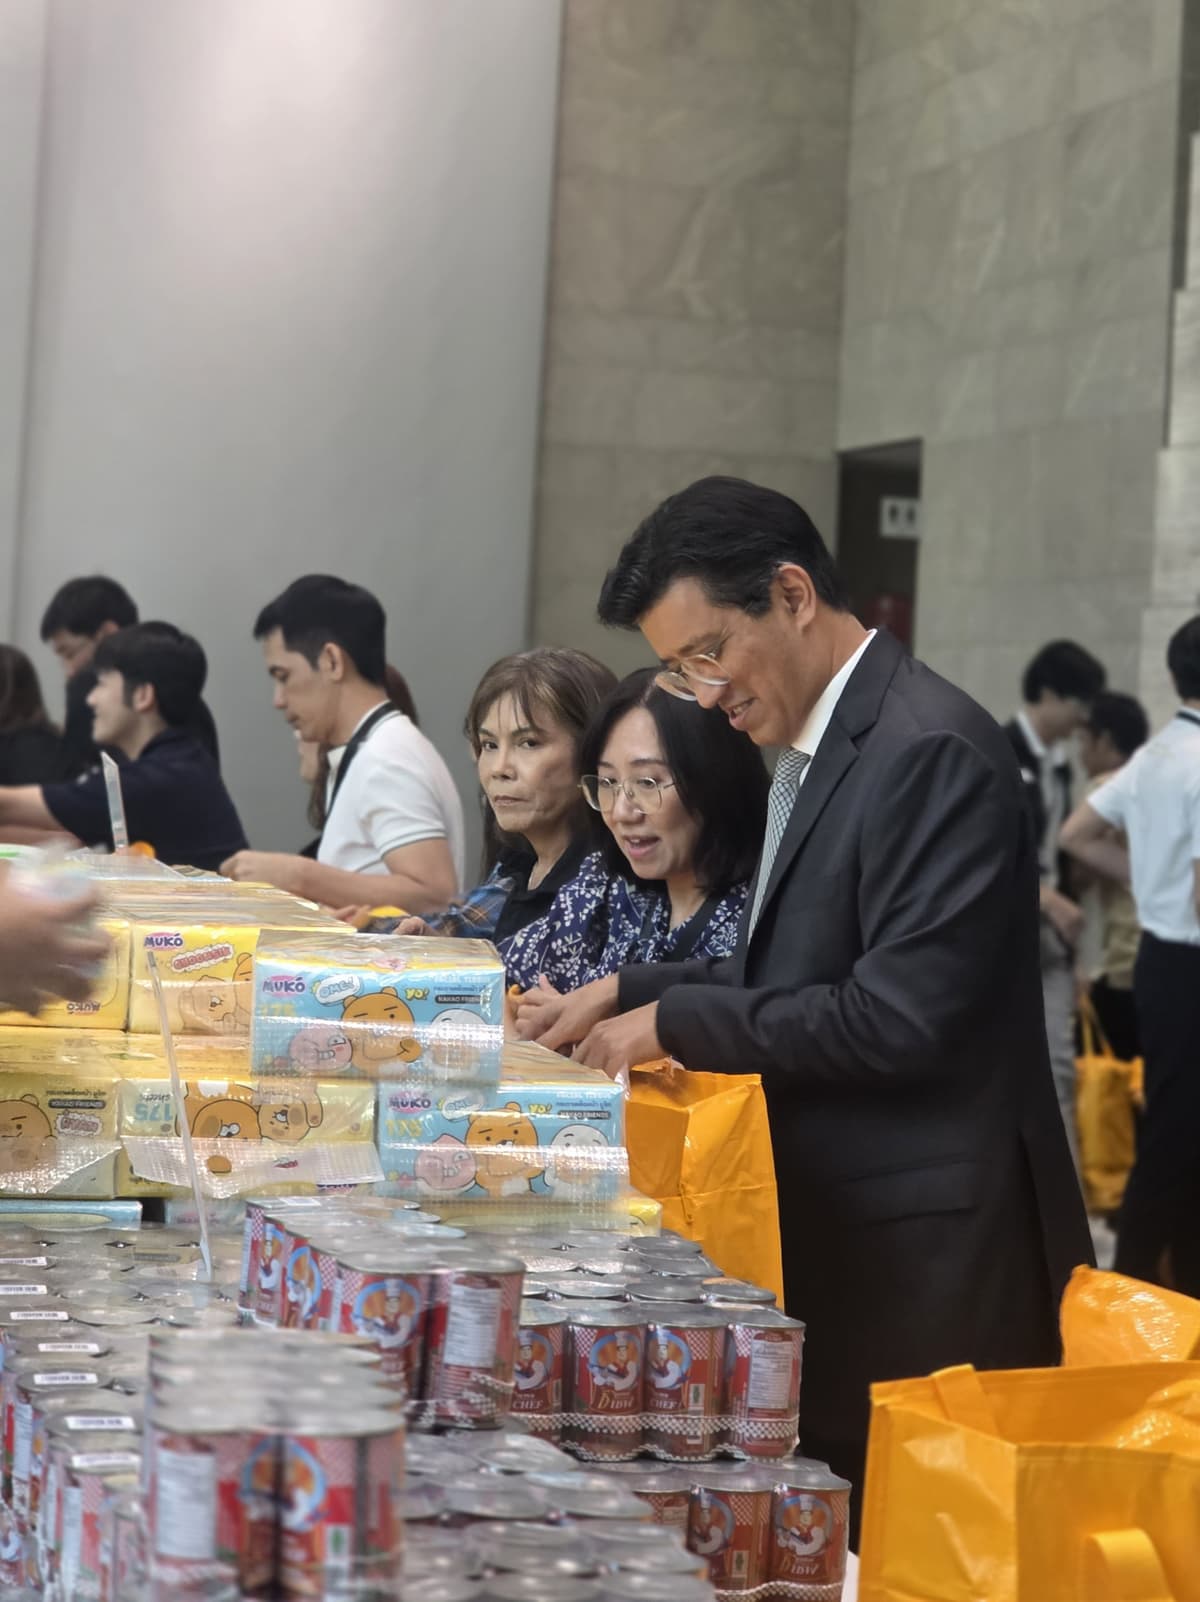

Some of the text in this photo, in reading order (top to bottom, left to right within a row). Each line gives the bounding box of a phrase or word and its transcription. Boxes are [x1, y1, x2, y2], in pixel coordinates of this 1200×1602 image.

[144, 933, 183, 947] MUKÓ
[262, 977, 306, 993] MUKÓ
[404, 987, 429, 1000] YO!
[135, 1104, 173, 1121] 175
[528, 1103, 552, 1117] YO!
